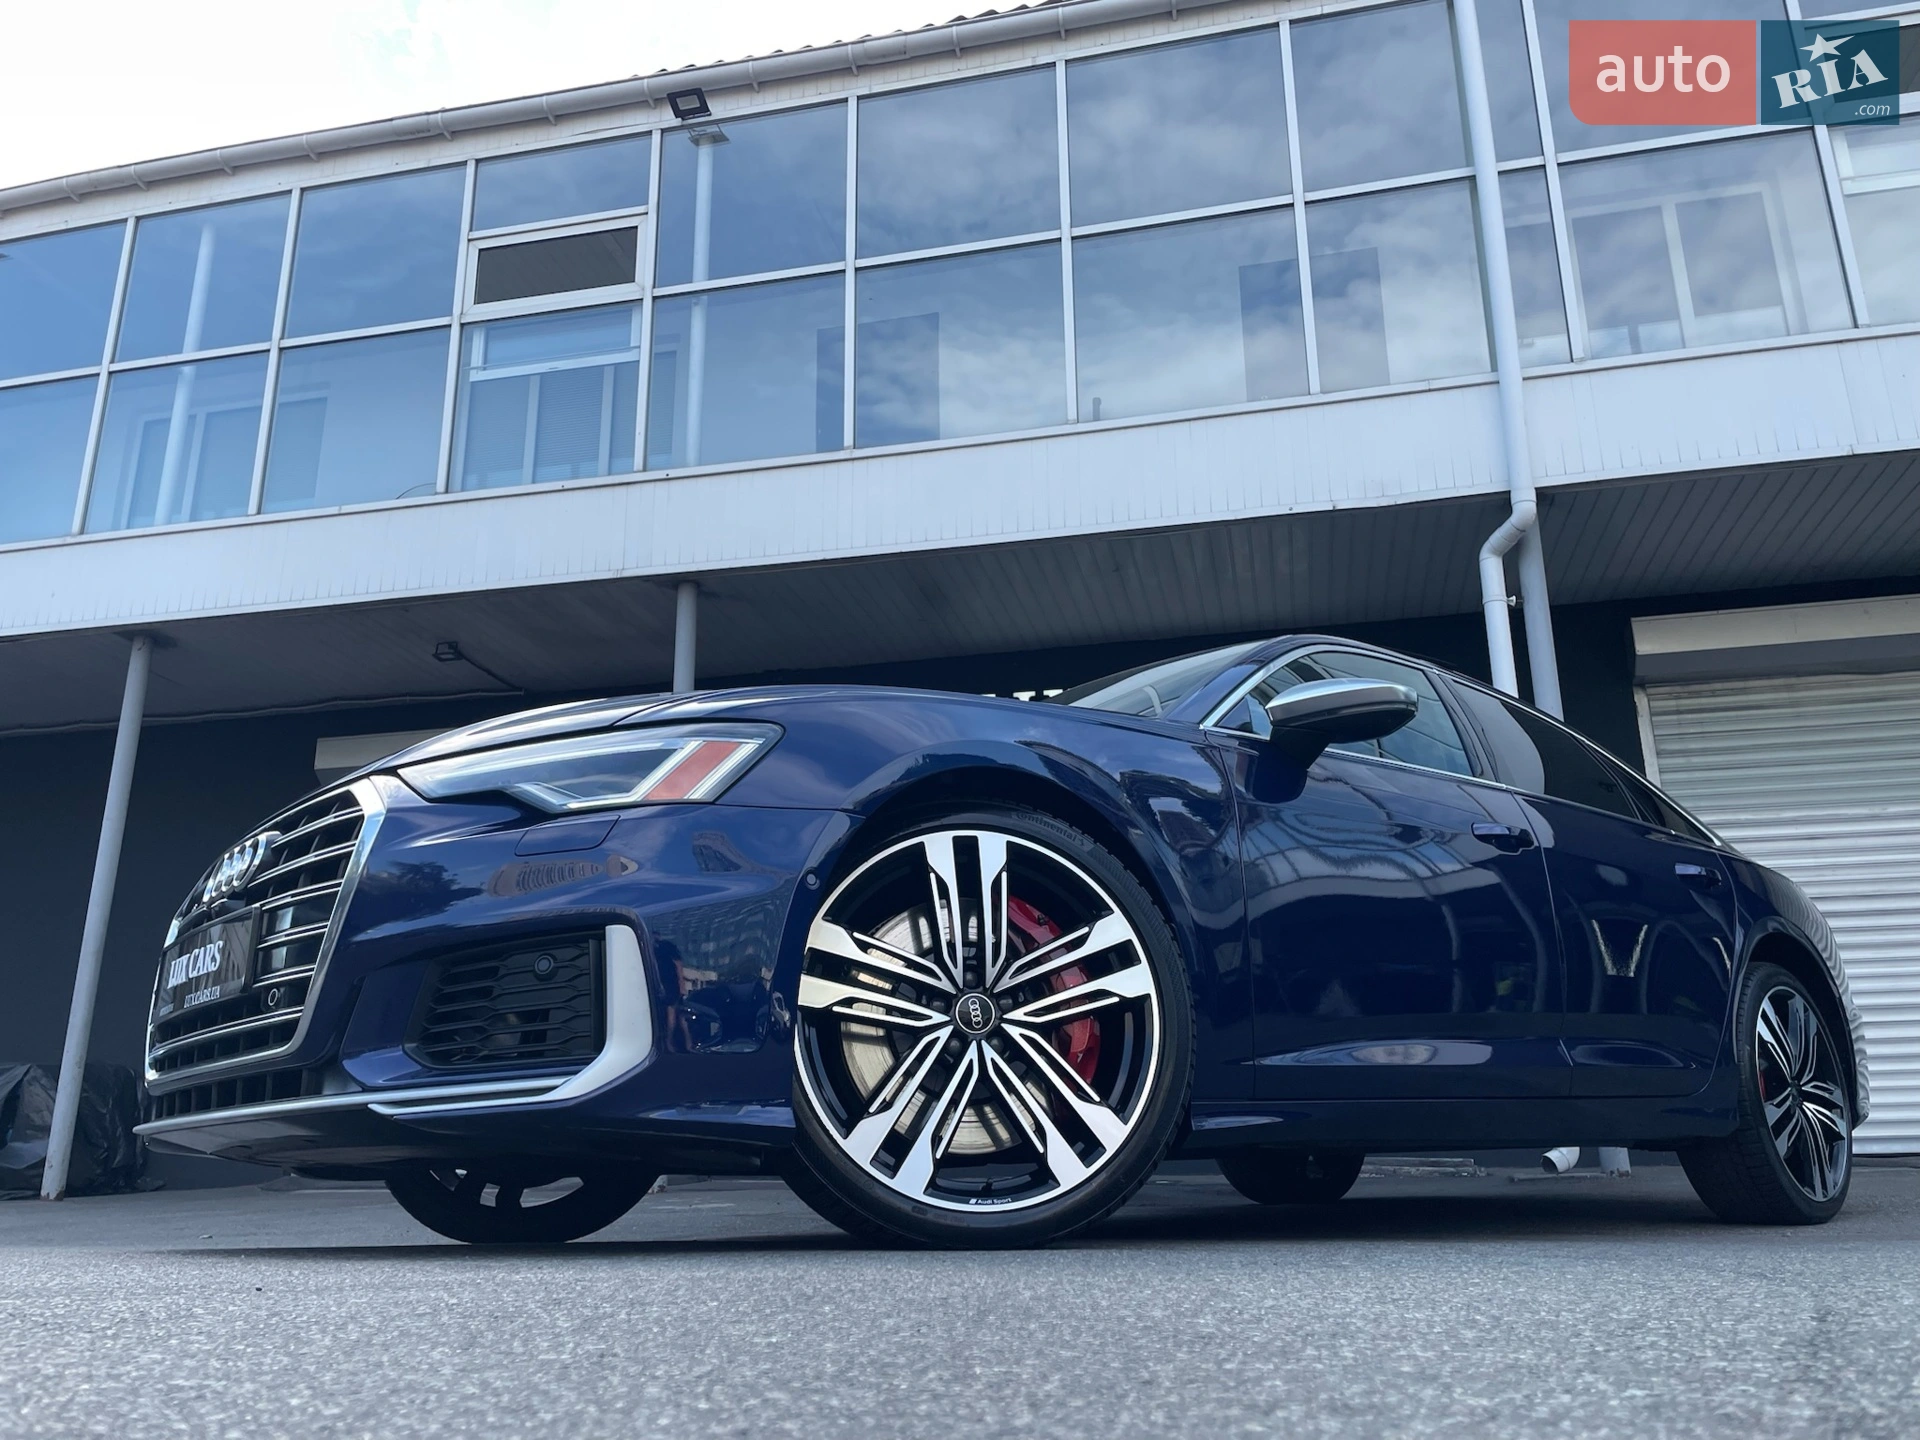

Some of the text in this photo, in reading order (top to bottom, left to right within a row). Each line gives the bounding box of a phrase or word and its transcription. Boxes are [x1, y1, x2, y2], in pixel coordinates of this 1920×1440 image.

[1016, 812, 1077, 842] Continental
[167, 940, 224, 990] LUX CARS
[994, 1197, 1011, 1205] Sport
